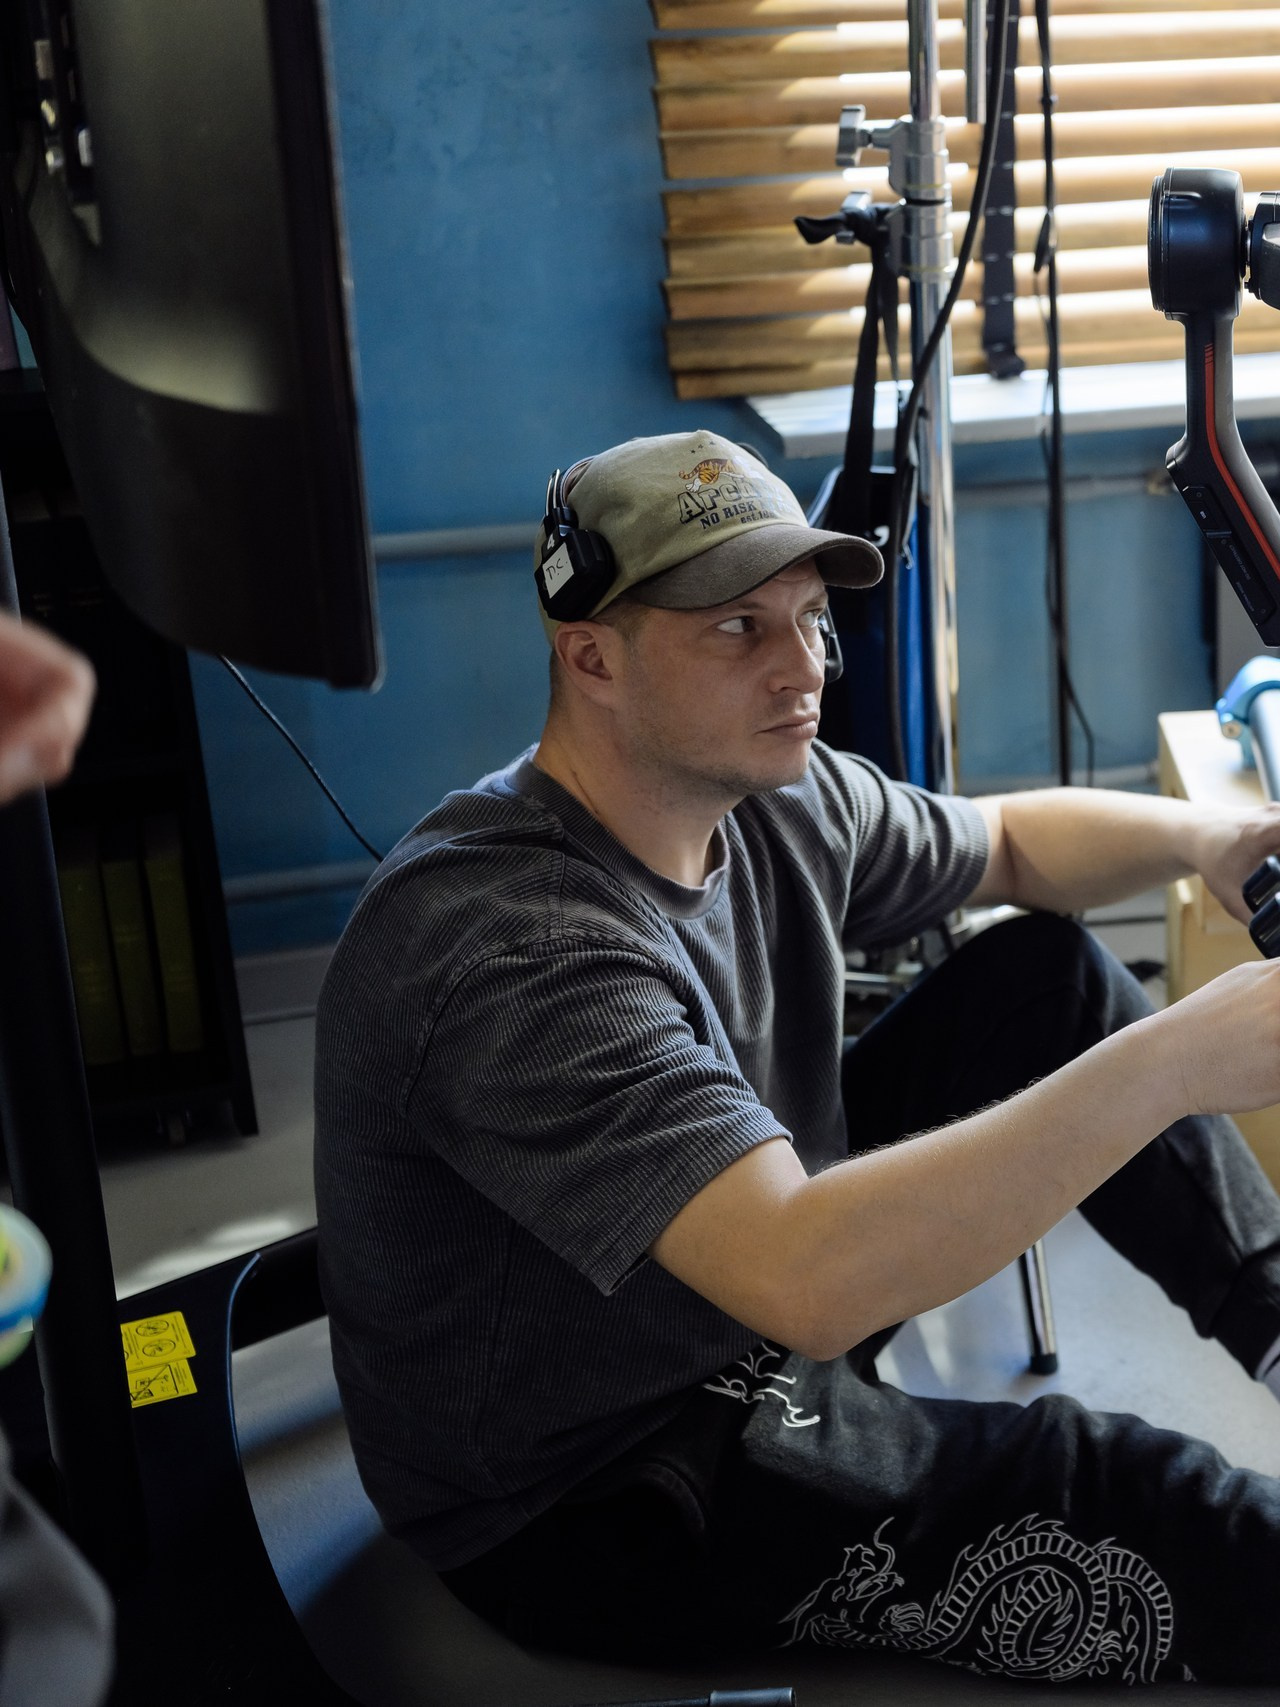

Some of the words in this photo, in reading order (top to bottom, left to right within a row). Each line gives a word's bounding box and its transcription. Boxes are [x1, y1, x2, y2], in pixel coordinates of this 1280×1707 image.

[700, 512, 720, 530] NO
[722, 500, 757, 520] RISK
[547, 532, 556, 550] 4
